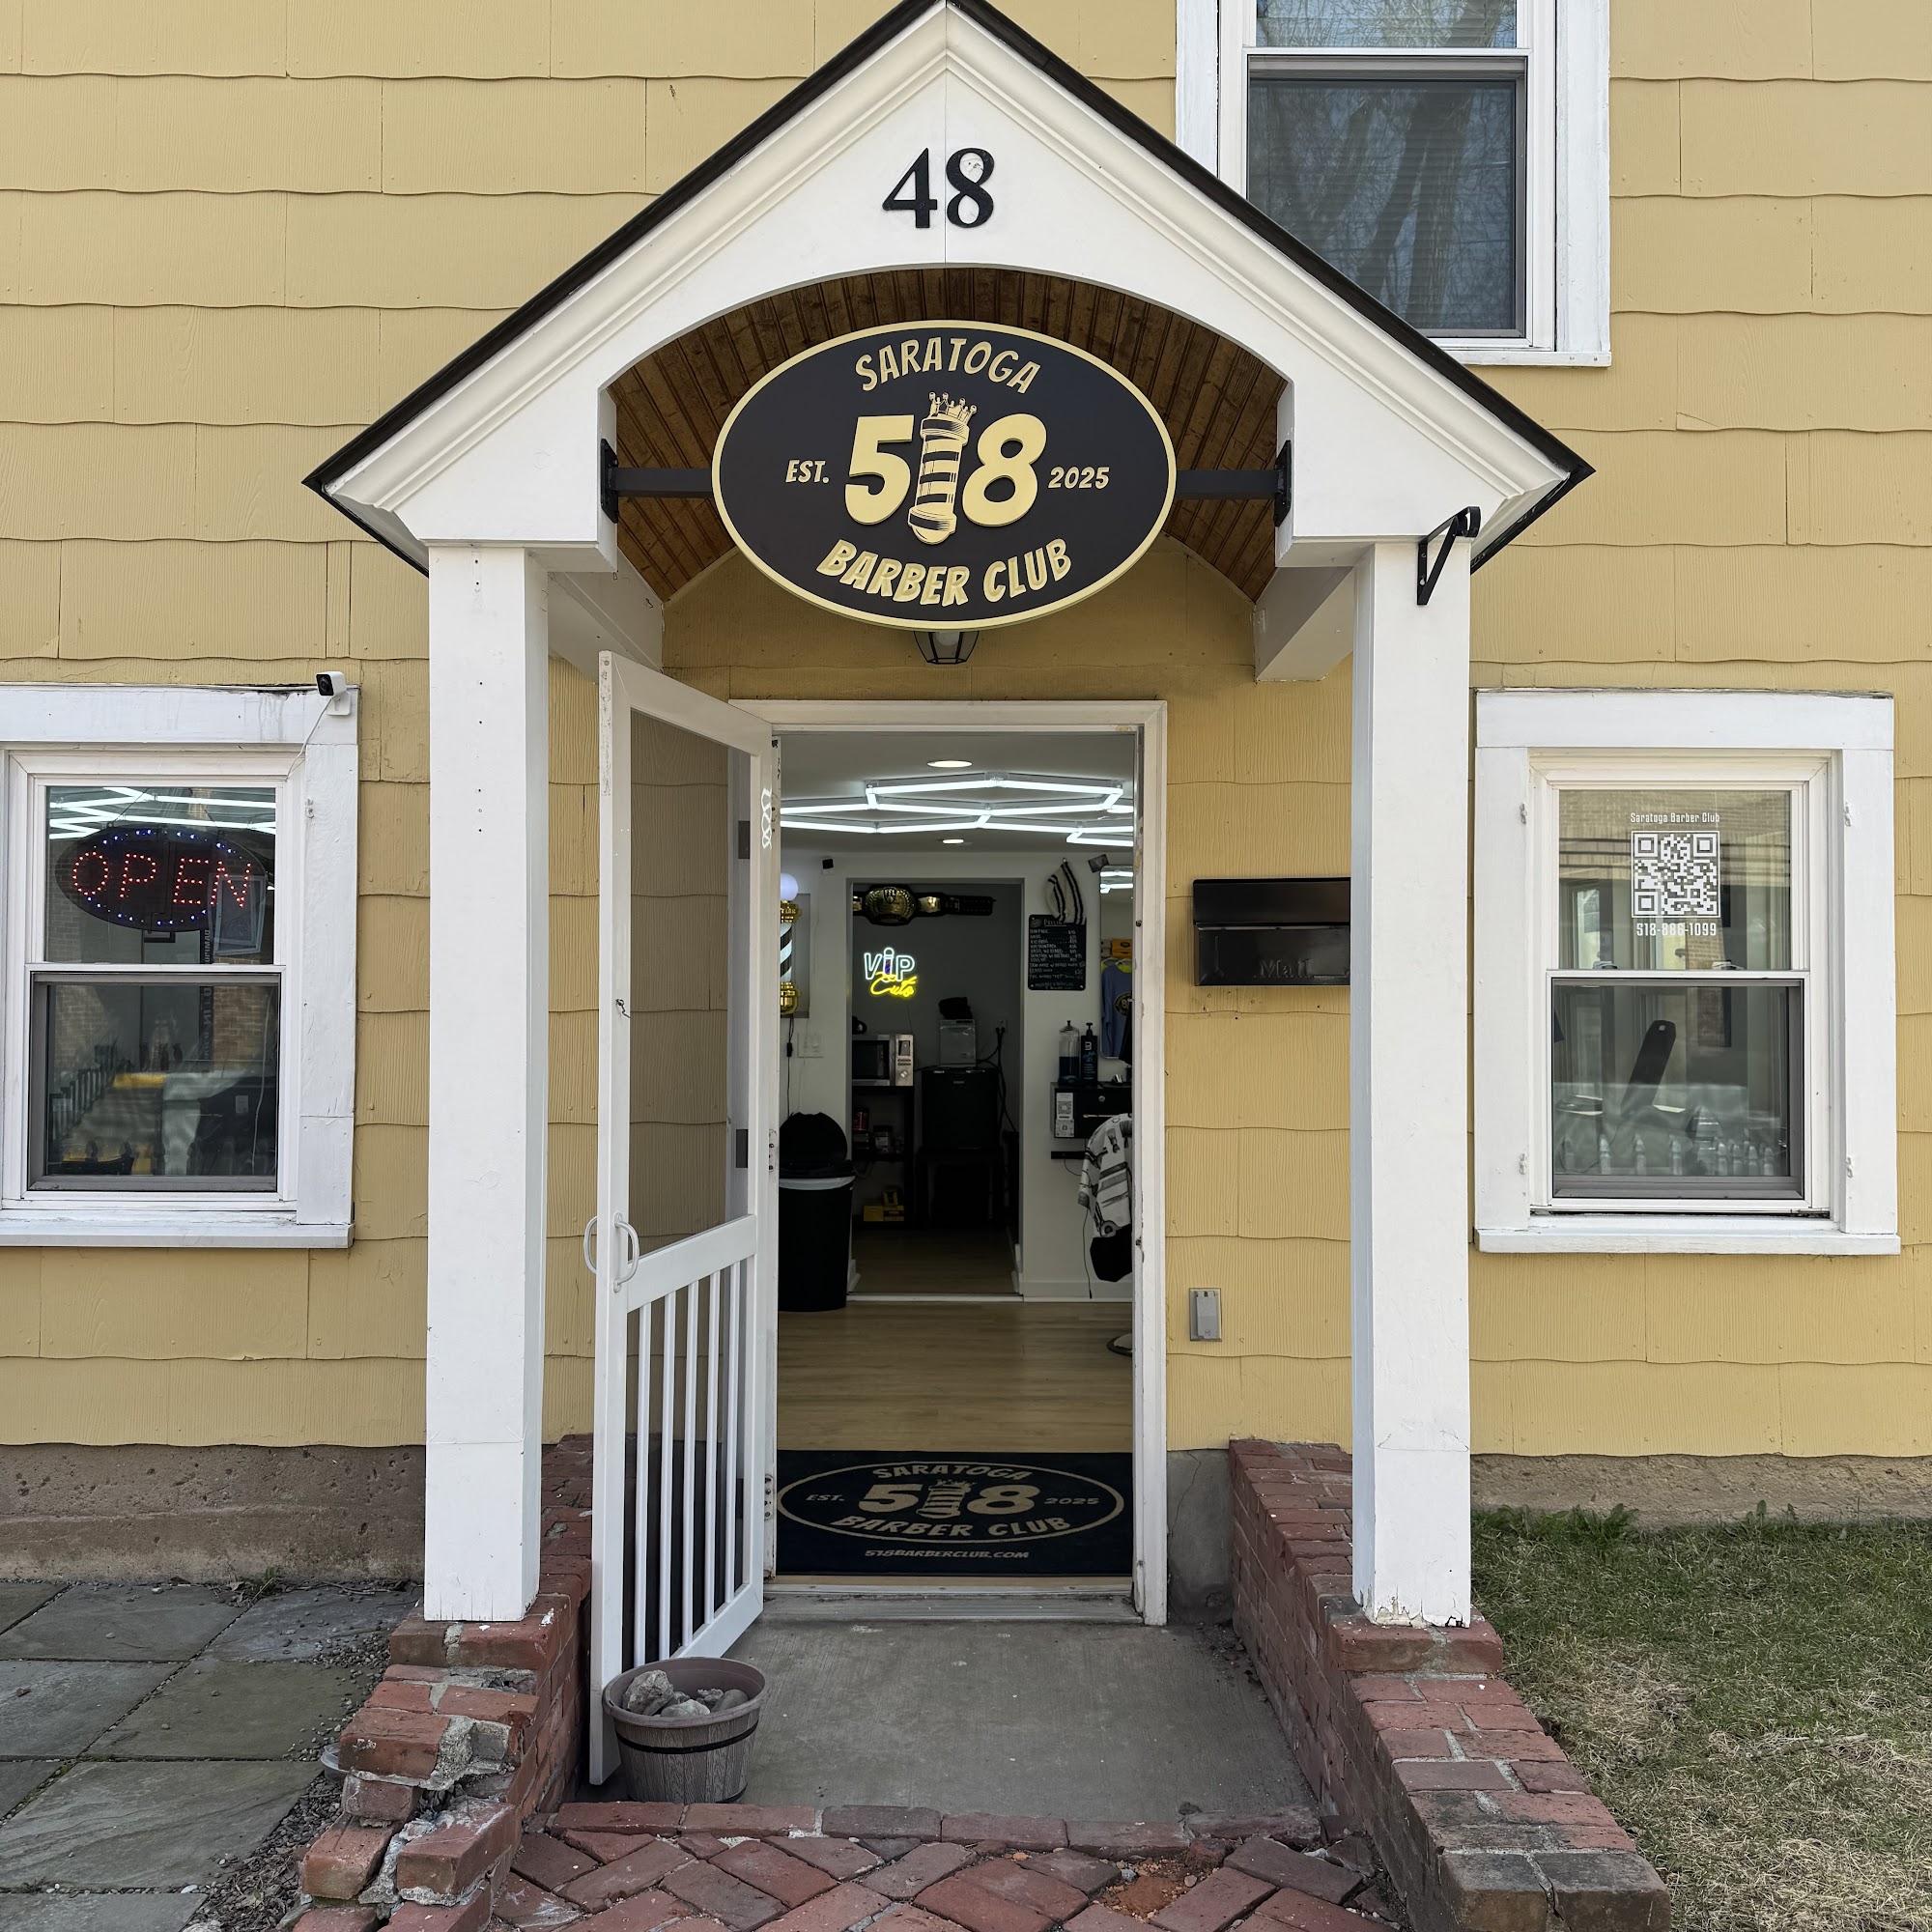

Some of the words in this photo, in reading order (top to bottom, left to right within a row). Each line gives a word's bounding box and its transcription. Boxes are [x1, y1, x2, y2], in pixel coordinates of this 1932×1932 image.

[882, 147, 994, 229] 48
[855, 336, 1040, 394] SARATOGA
[785, 459, 829, 484] EST.
[1047, 466, 1110, 490] 2025
[816, 538, 969, 607] BARBER
[981, 538, 1072, 603] CLUB
[1631, 812, 1668, 824] Saratoga
[1670, 812, 1699, 823] Barber
[1702, 812, 1720, 823] Club
[72, 851, 251, 907] OPEN
[1636, 923, 1717, 936] 518-886-1099
[872, 1463, 1033, 1481] SARATOGA
[806, 1493, 845, 1503] EST.
[1043, 1496, 1099, 1505] 2025
[830, 1516, 973, 1537] BARBER
[987, 1517, 1072, 1537] CLUB
[864, 1548, 1030, 1559] 518BARBERCLUB.COM
